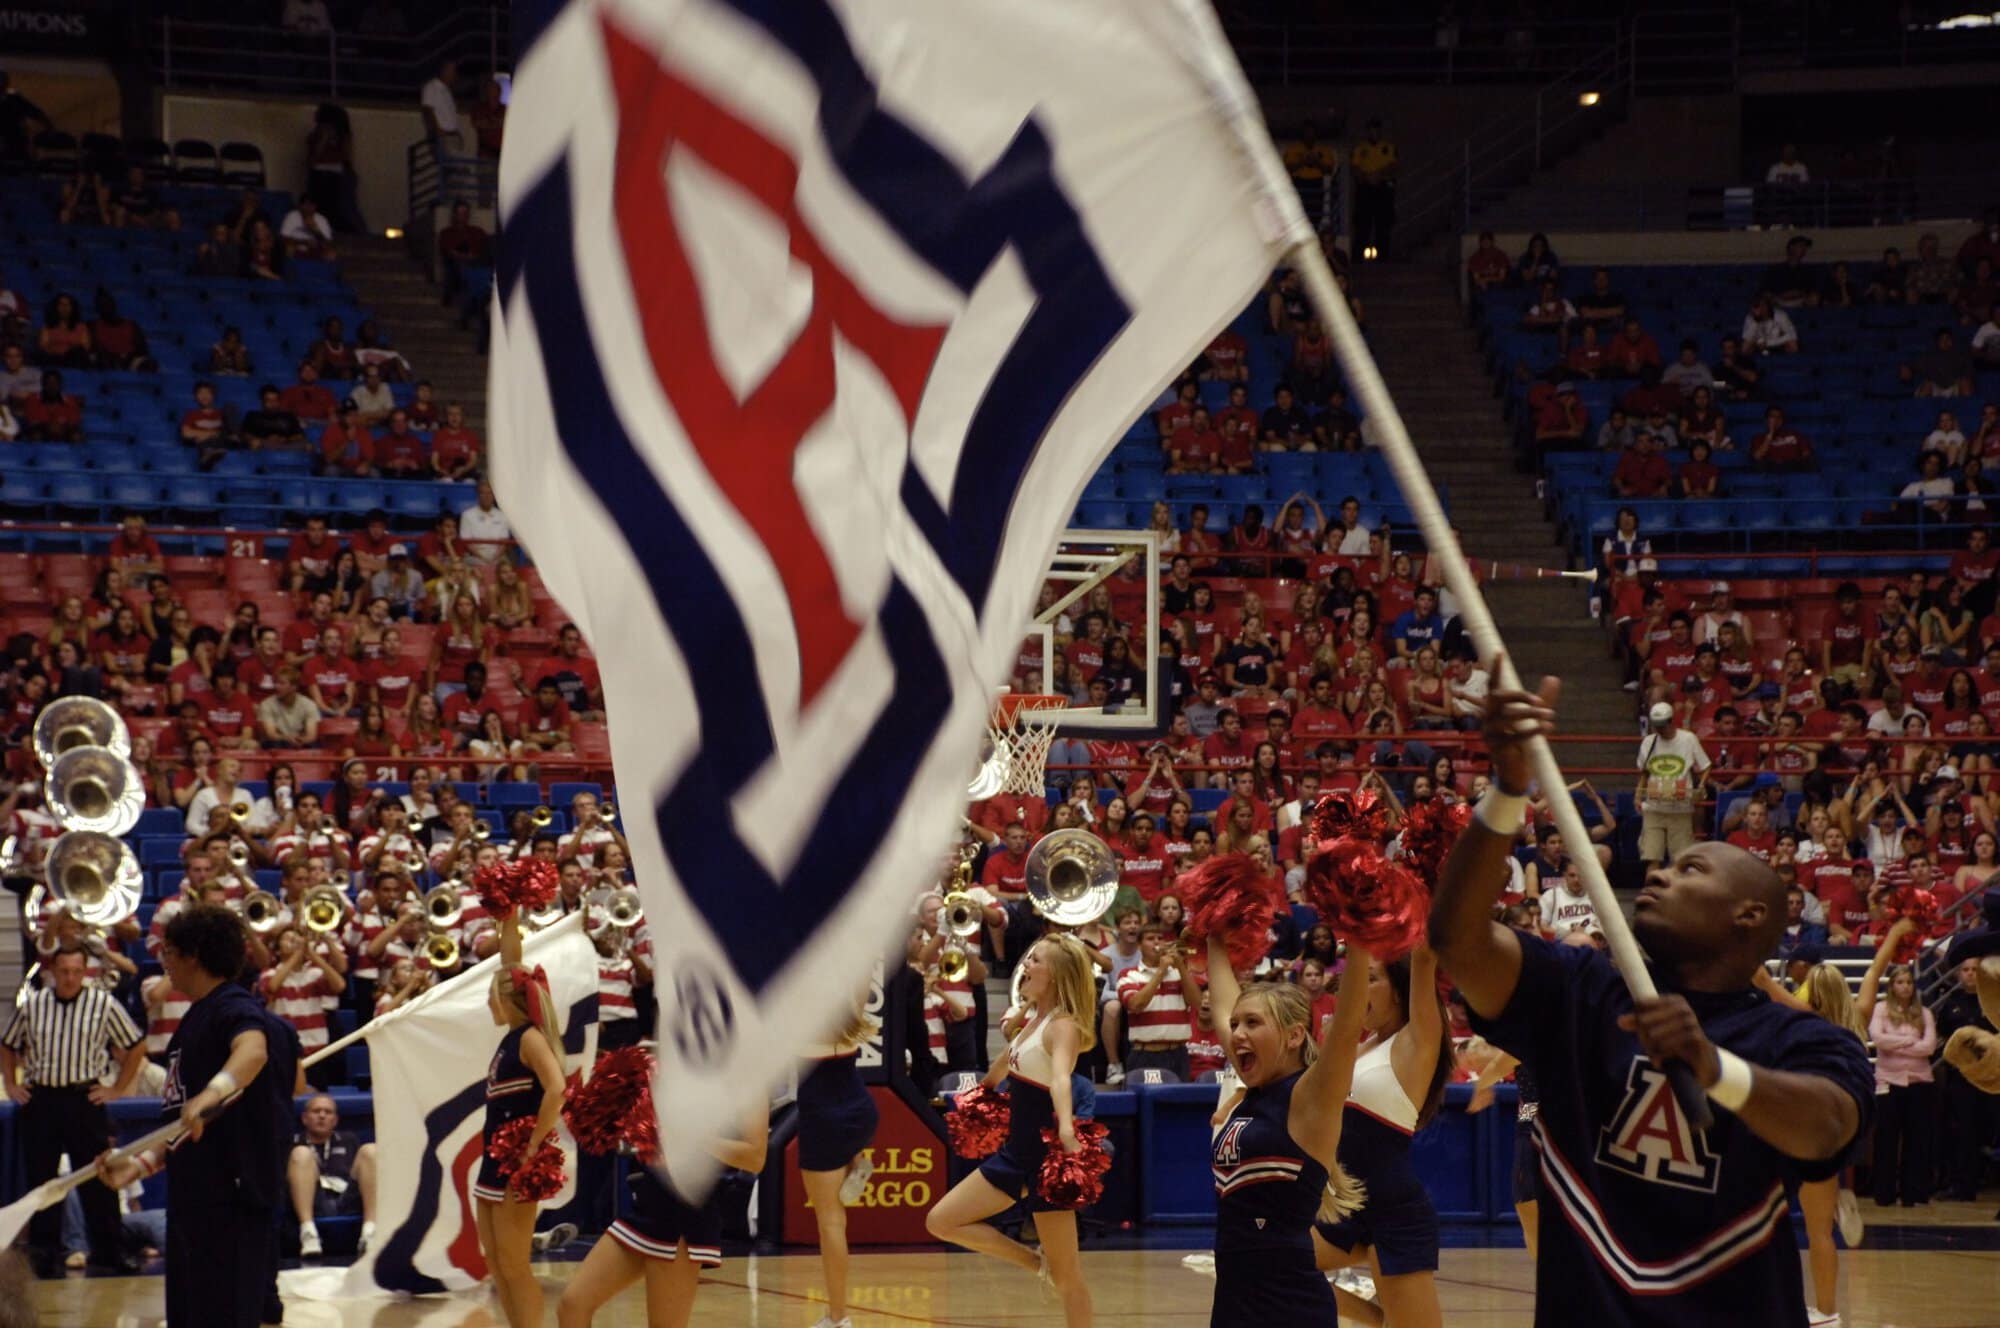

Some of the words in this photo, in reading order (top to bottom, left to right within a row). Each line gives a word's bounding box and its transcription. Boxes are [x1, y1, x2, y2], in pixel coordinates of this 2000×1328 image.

[231, 539, 256, 558] 21
[376, 766, 399, 784] 21
[1594, 1054, 1722, 1195] A
[1214, 1117, 1254, 1166] A
[862, 1147, 933, 1174] LLS
[842, 1180, 931, 1208] RGO
